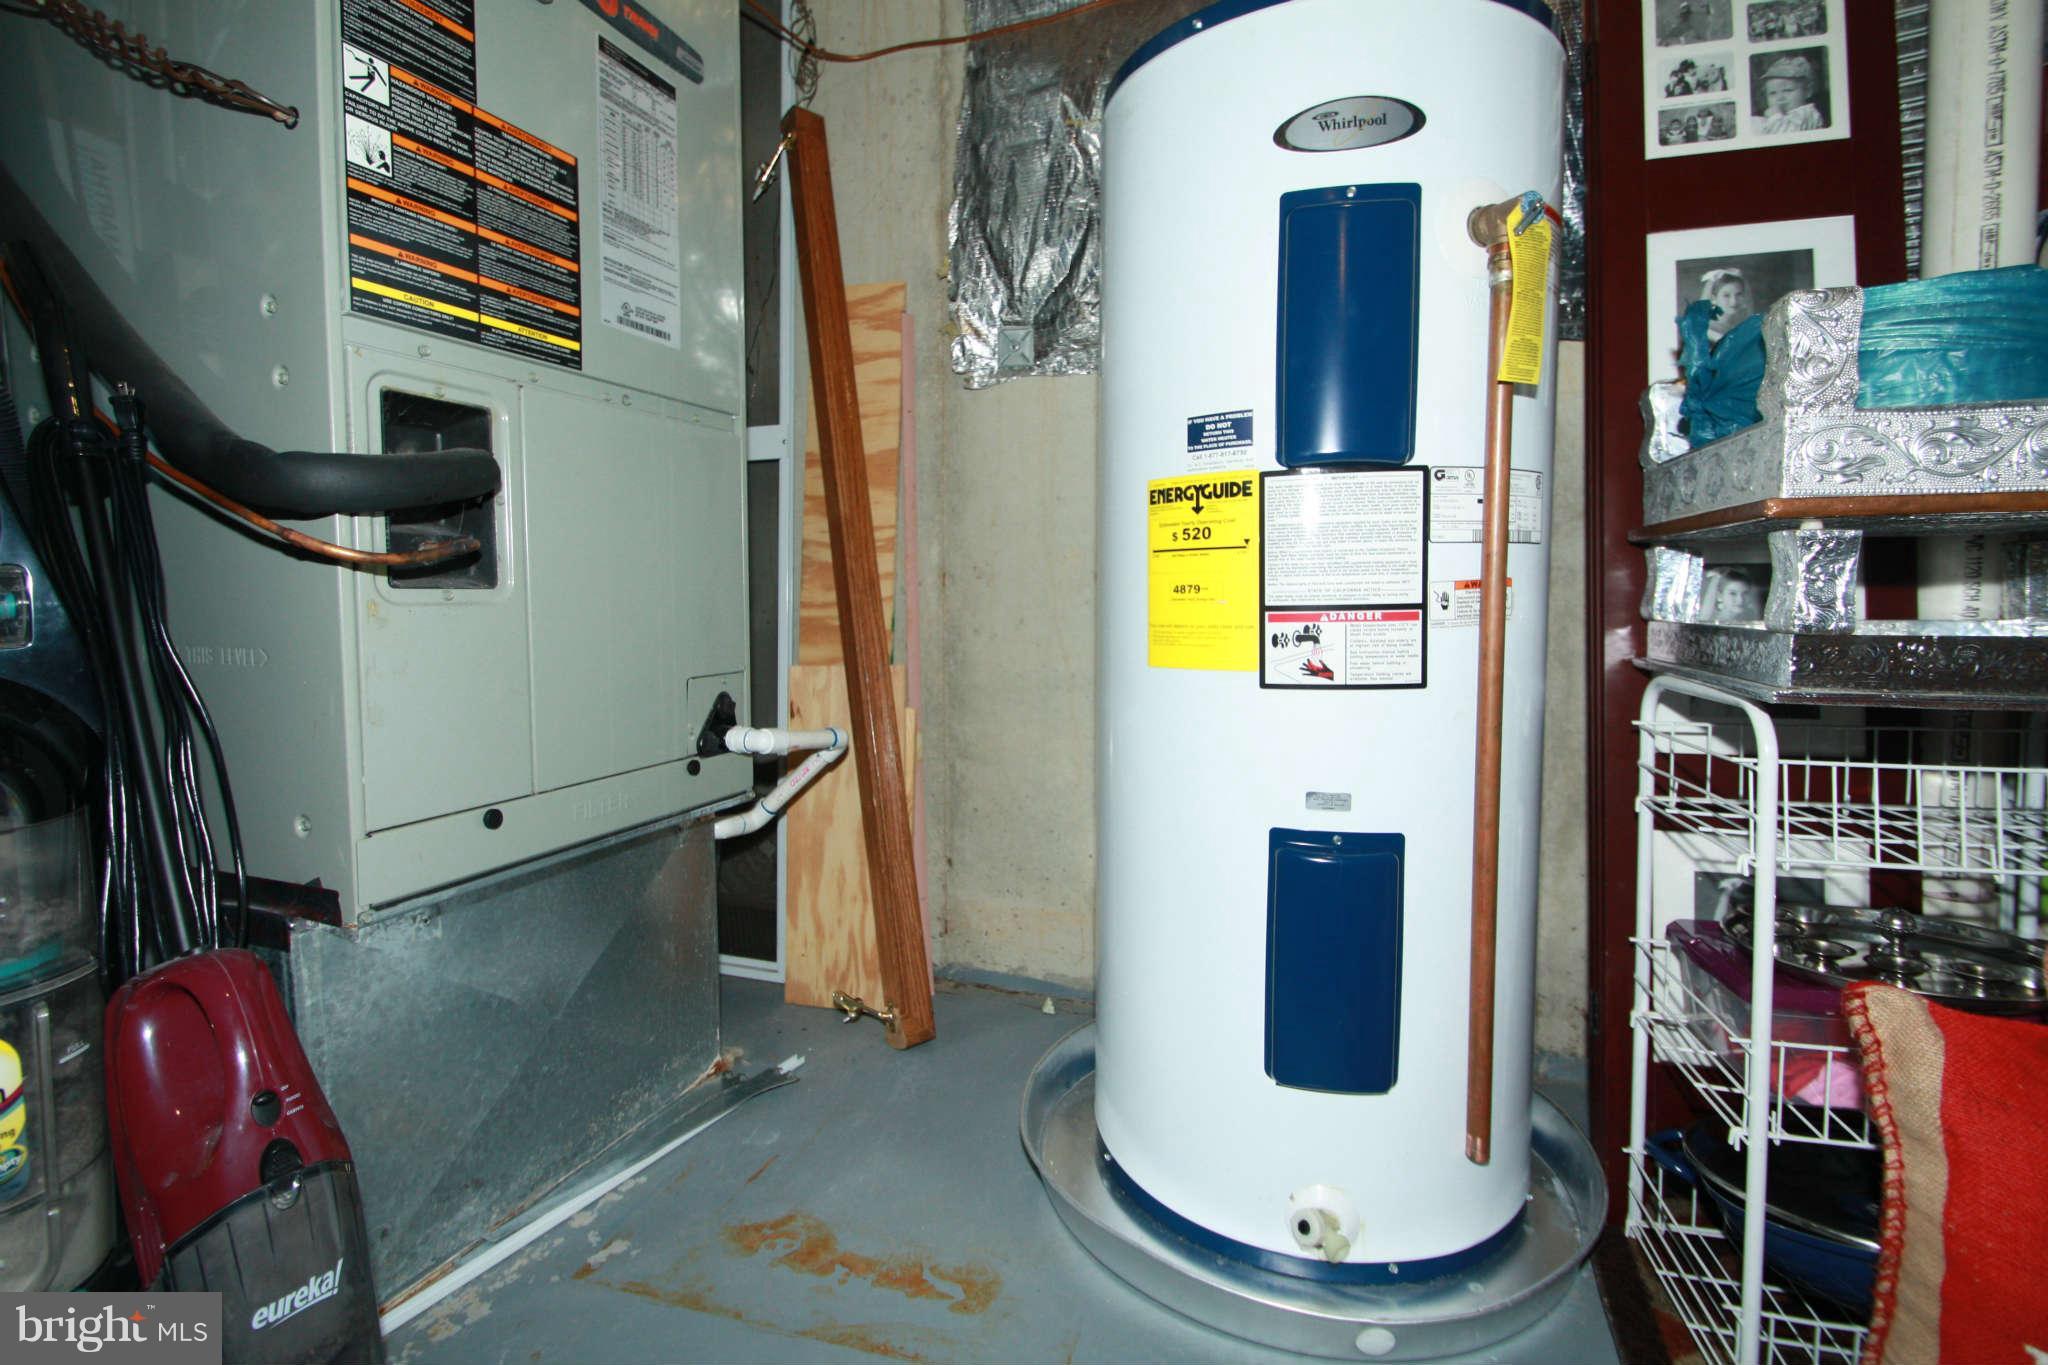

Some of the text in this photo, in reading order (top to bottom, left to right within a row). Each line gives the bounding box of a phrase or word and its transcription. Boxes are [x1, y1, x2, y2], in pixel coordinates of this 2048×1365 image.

[419, 81, 451, 102] WARNING
[1318, 113, 1387, 132] Whirlpool
[421, 147, 453, 166] WARNING
[402, 199, 435, 216] WARNING
[404, 253, 437, 268] WARNING
[403, 293, 434, 307] CAUTION
[518, 326, 547, 339] ATTENTION
[1172, 527, 1211, 542] $ 520
[1173, 584, 1200, 594] 4879
[1330, 612, 1382, 621] DANGER
